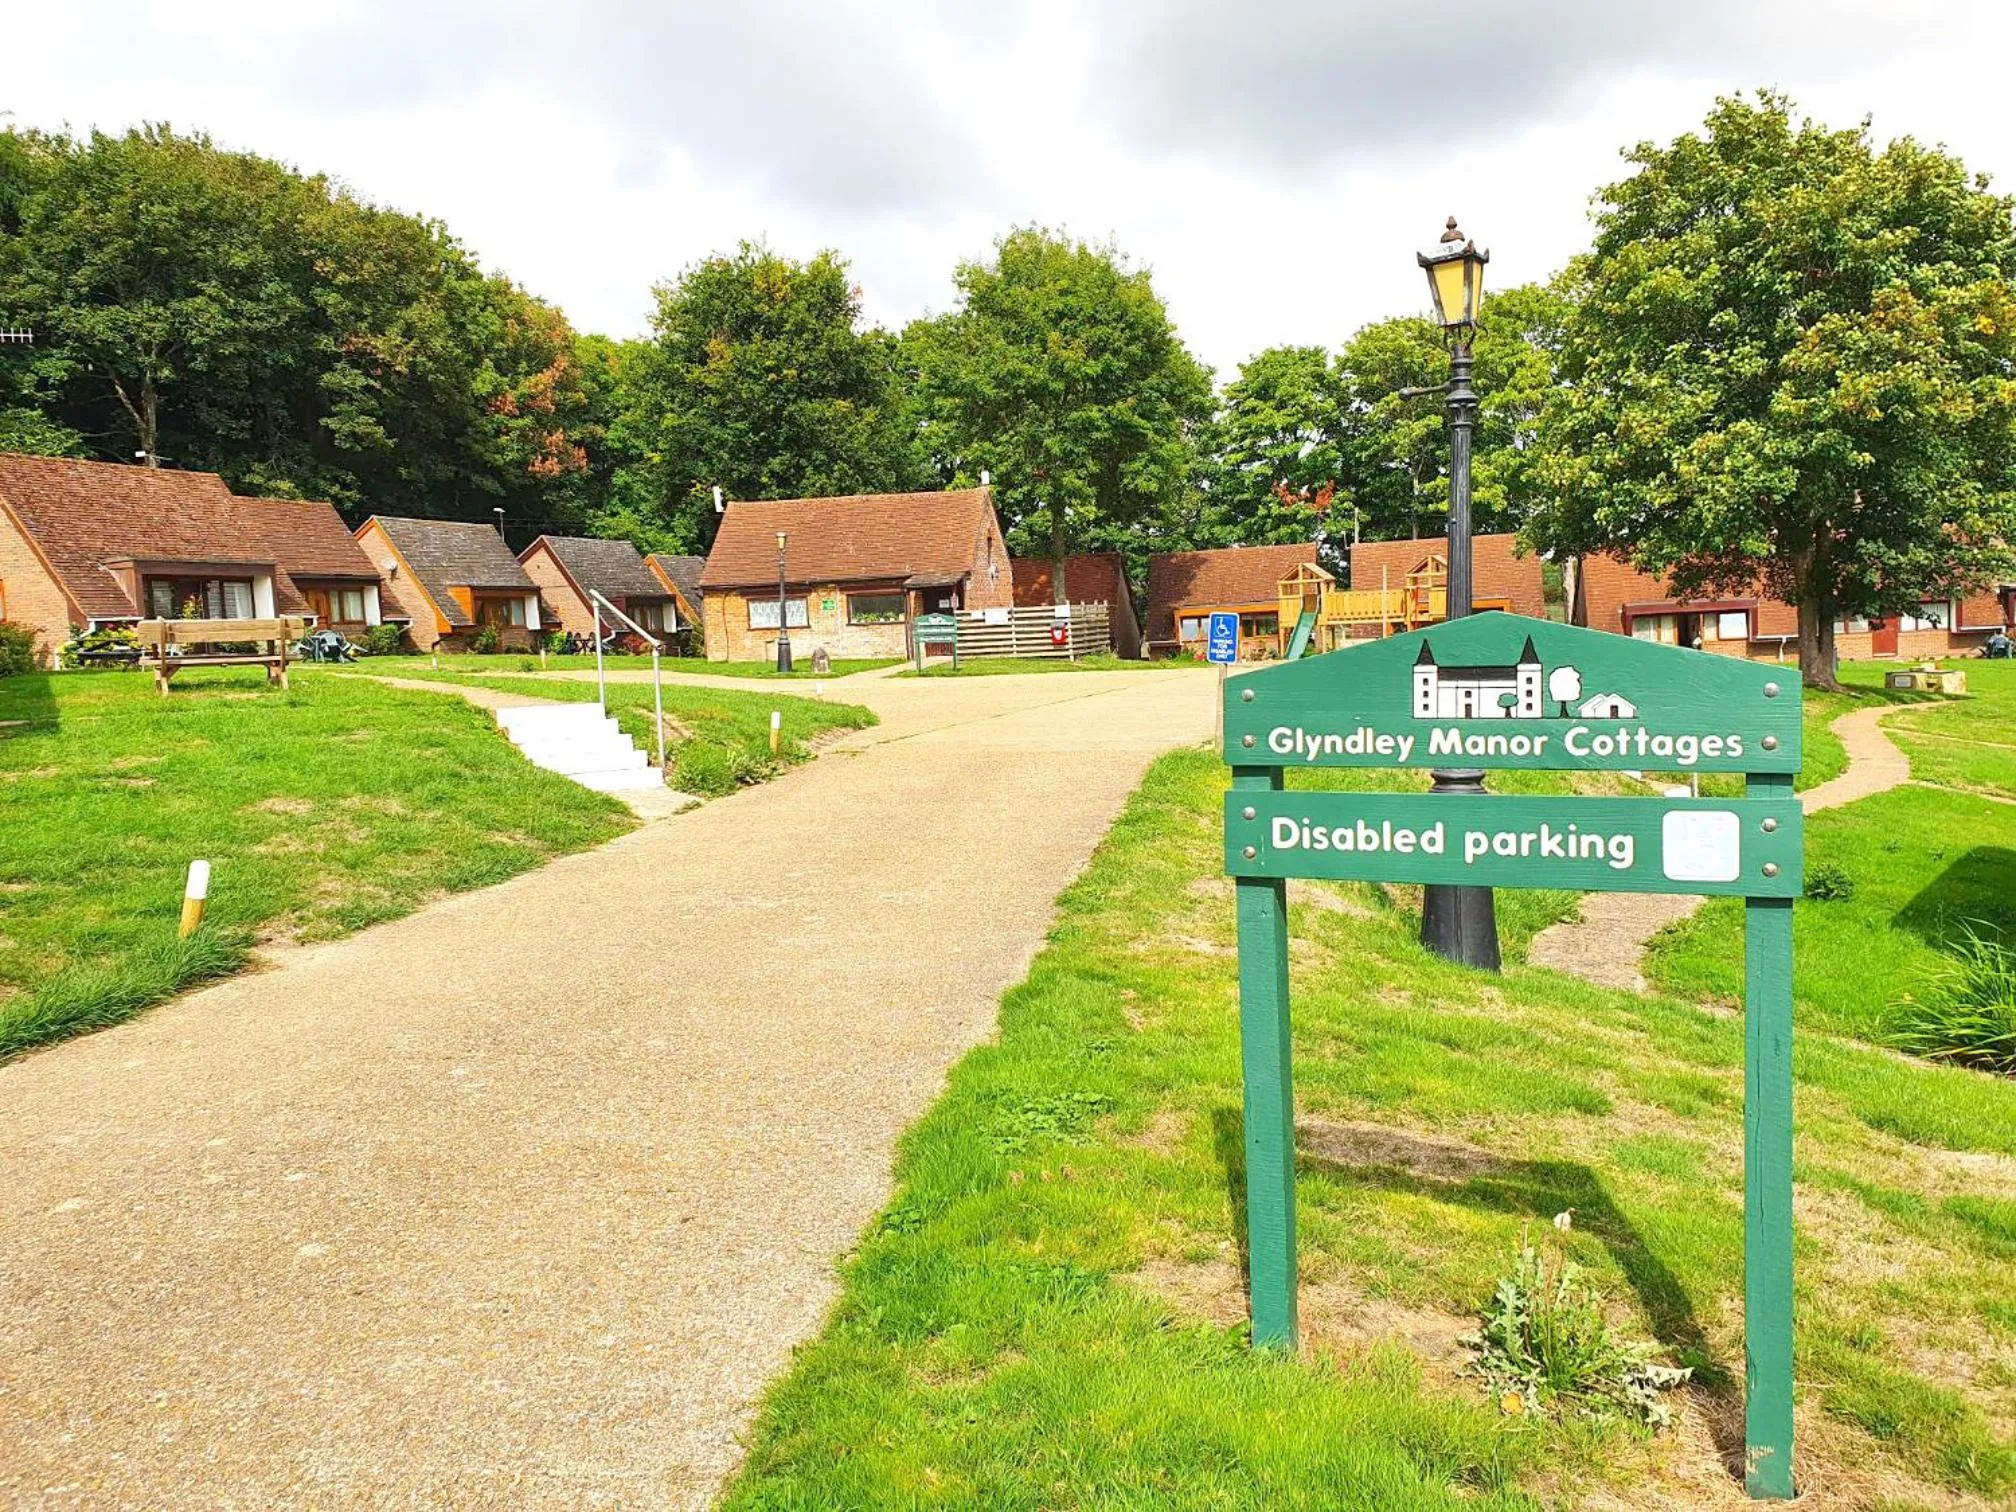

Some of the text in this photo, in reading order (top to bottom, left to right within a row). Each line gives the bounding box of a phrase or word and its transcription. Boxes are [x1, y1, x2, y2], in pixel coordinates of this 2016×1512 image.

[1268, 726, 1744, 767] Glyndley Manor Cottages
[1272, 816, 1633, 869] Disabled parking
